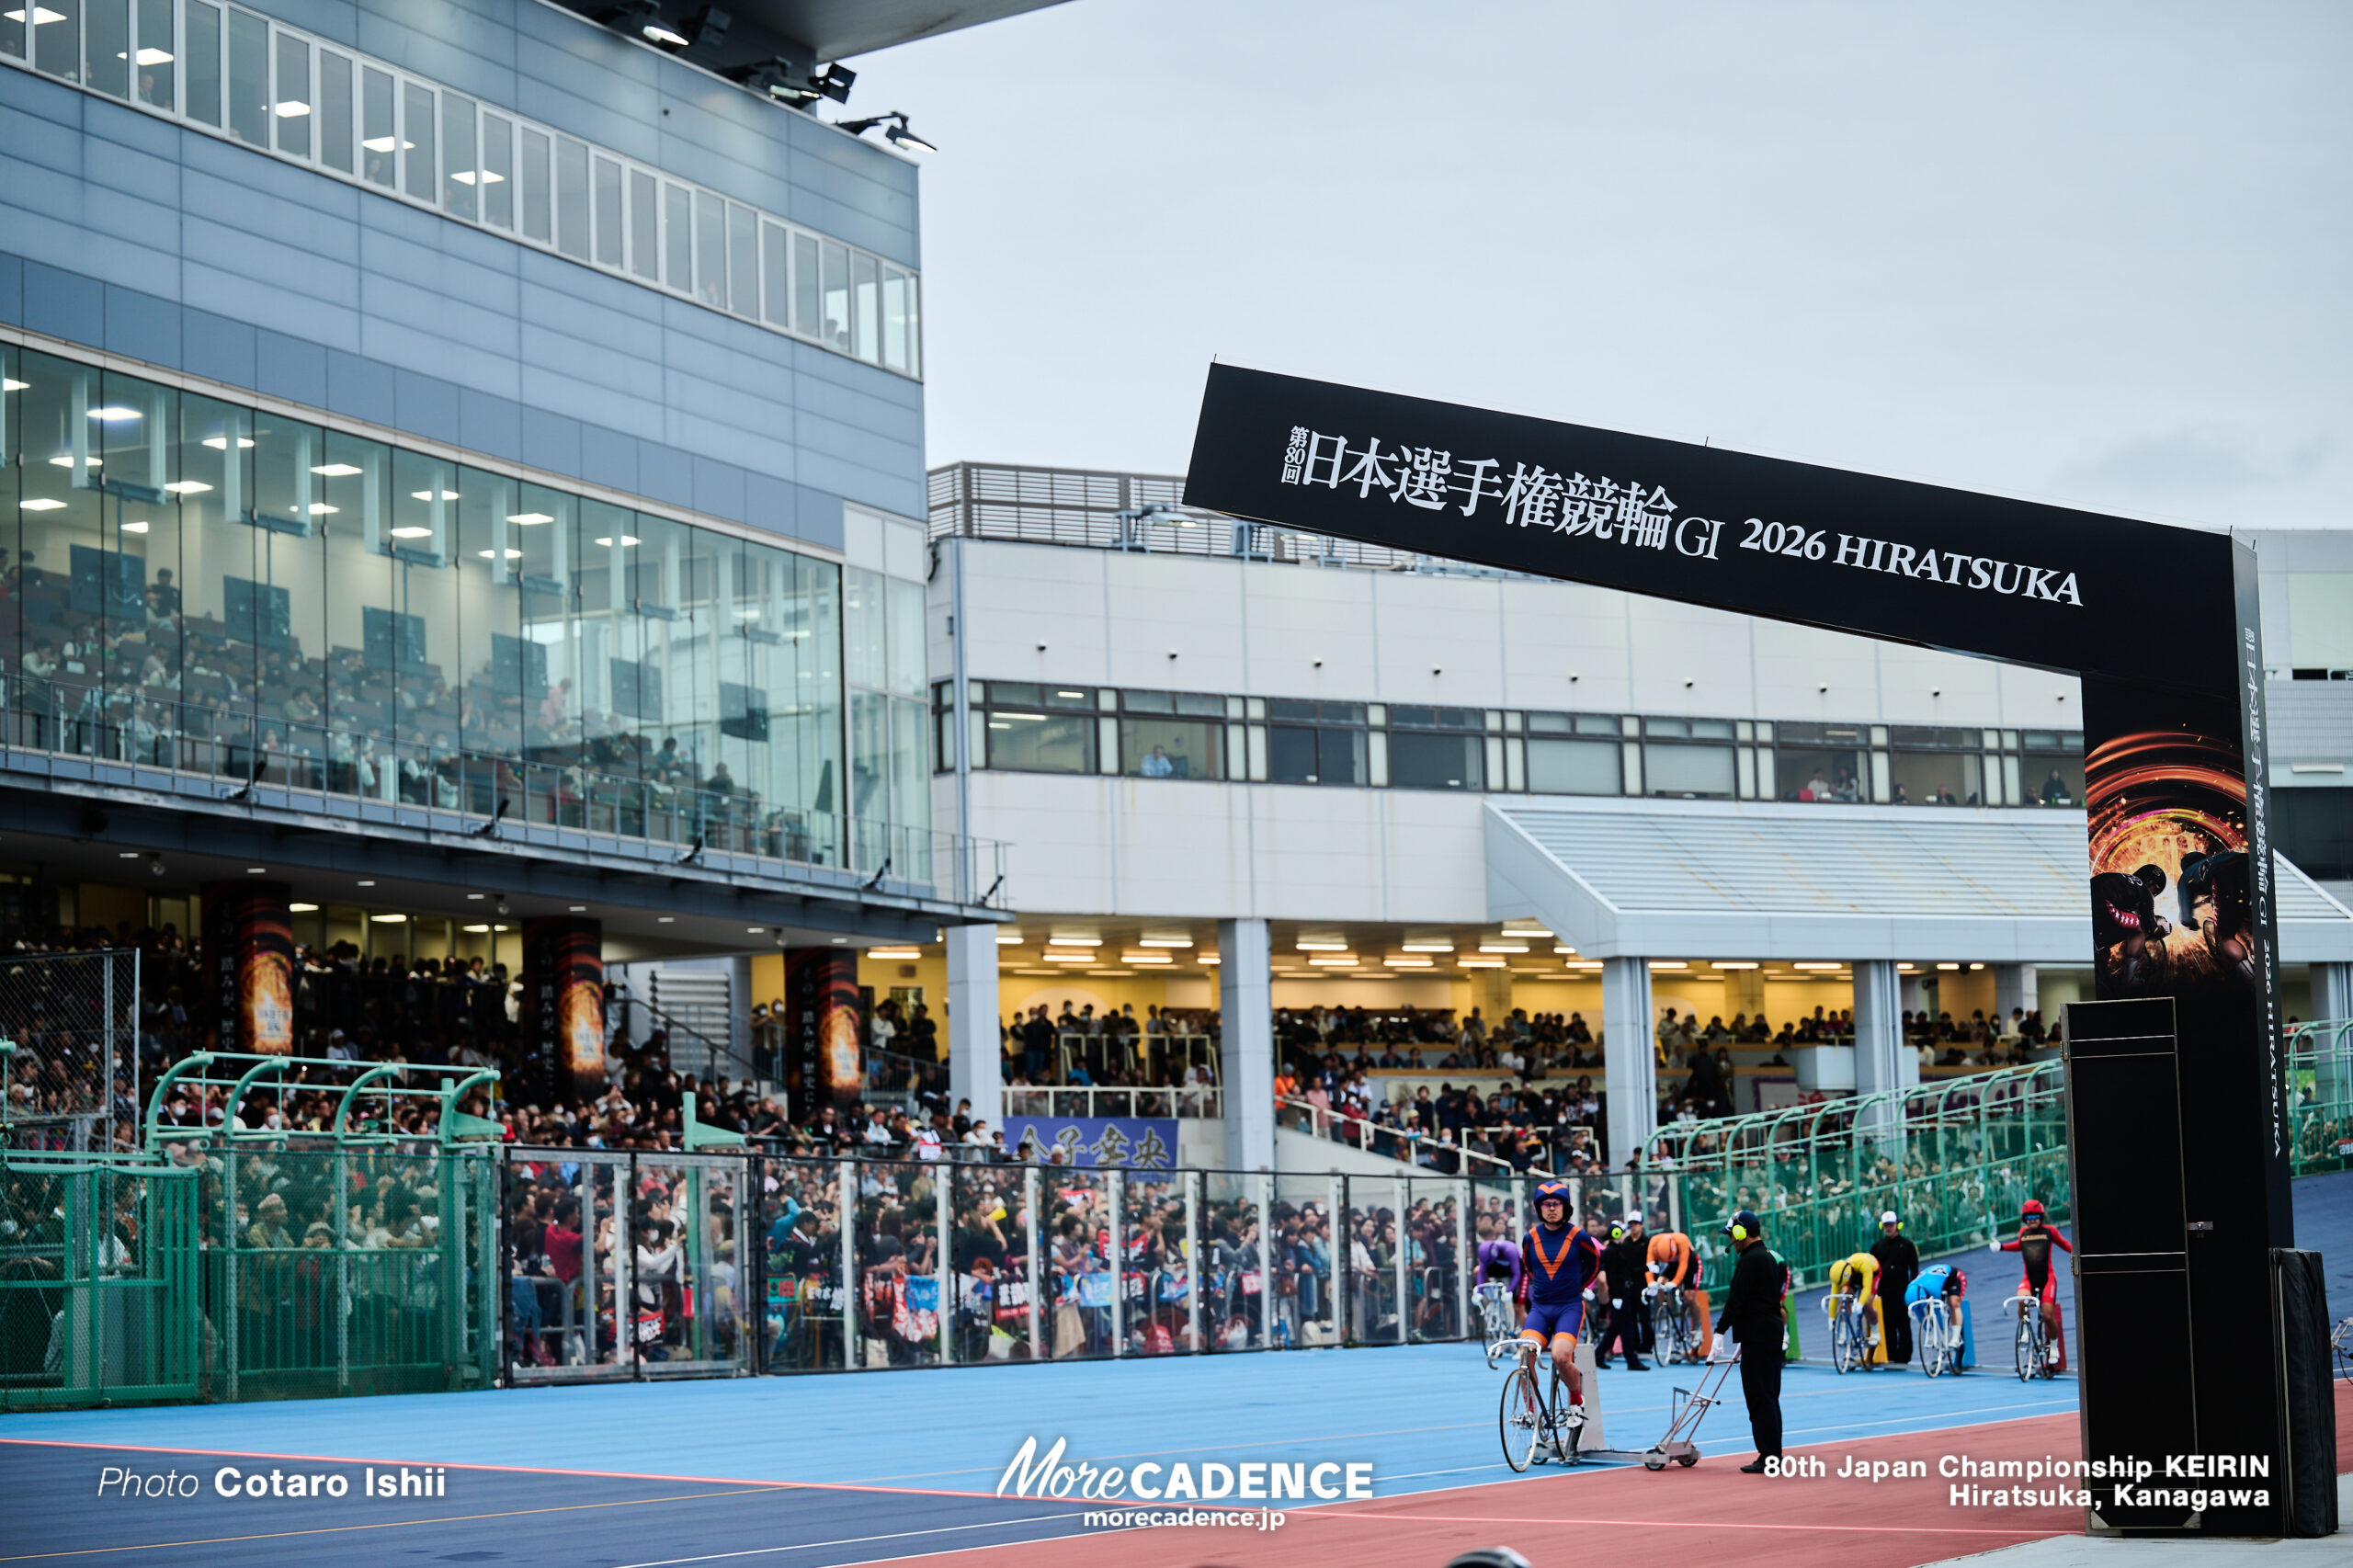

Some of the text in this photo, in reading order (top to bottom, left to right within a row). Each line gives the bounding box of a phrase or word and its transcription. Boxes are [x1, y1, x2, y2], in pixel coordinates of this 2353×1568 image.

[1280, 425, 1310, 485] 第80回
[1739, 517, 1826, 561] 2026
[1832, 533, 2085, 607] HIRATSUKA
[2262, 939, 2272, 994] 2026
[2266, 1000, 2280, 1158] HIRATSUKA
